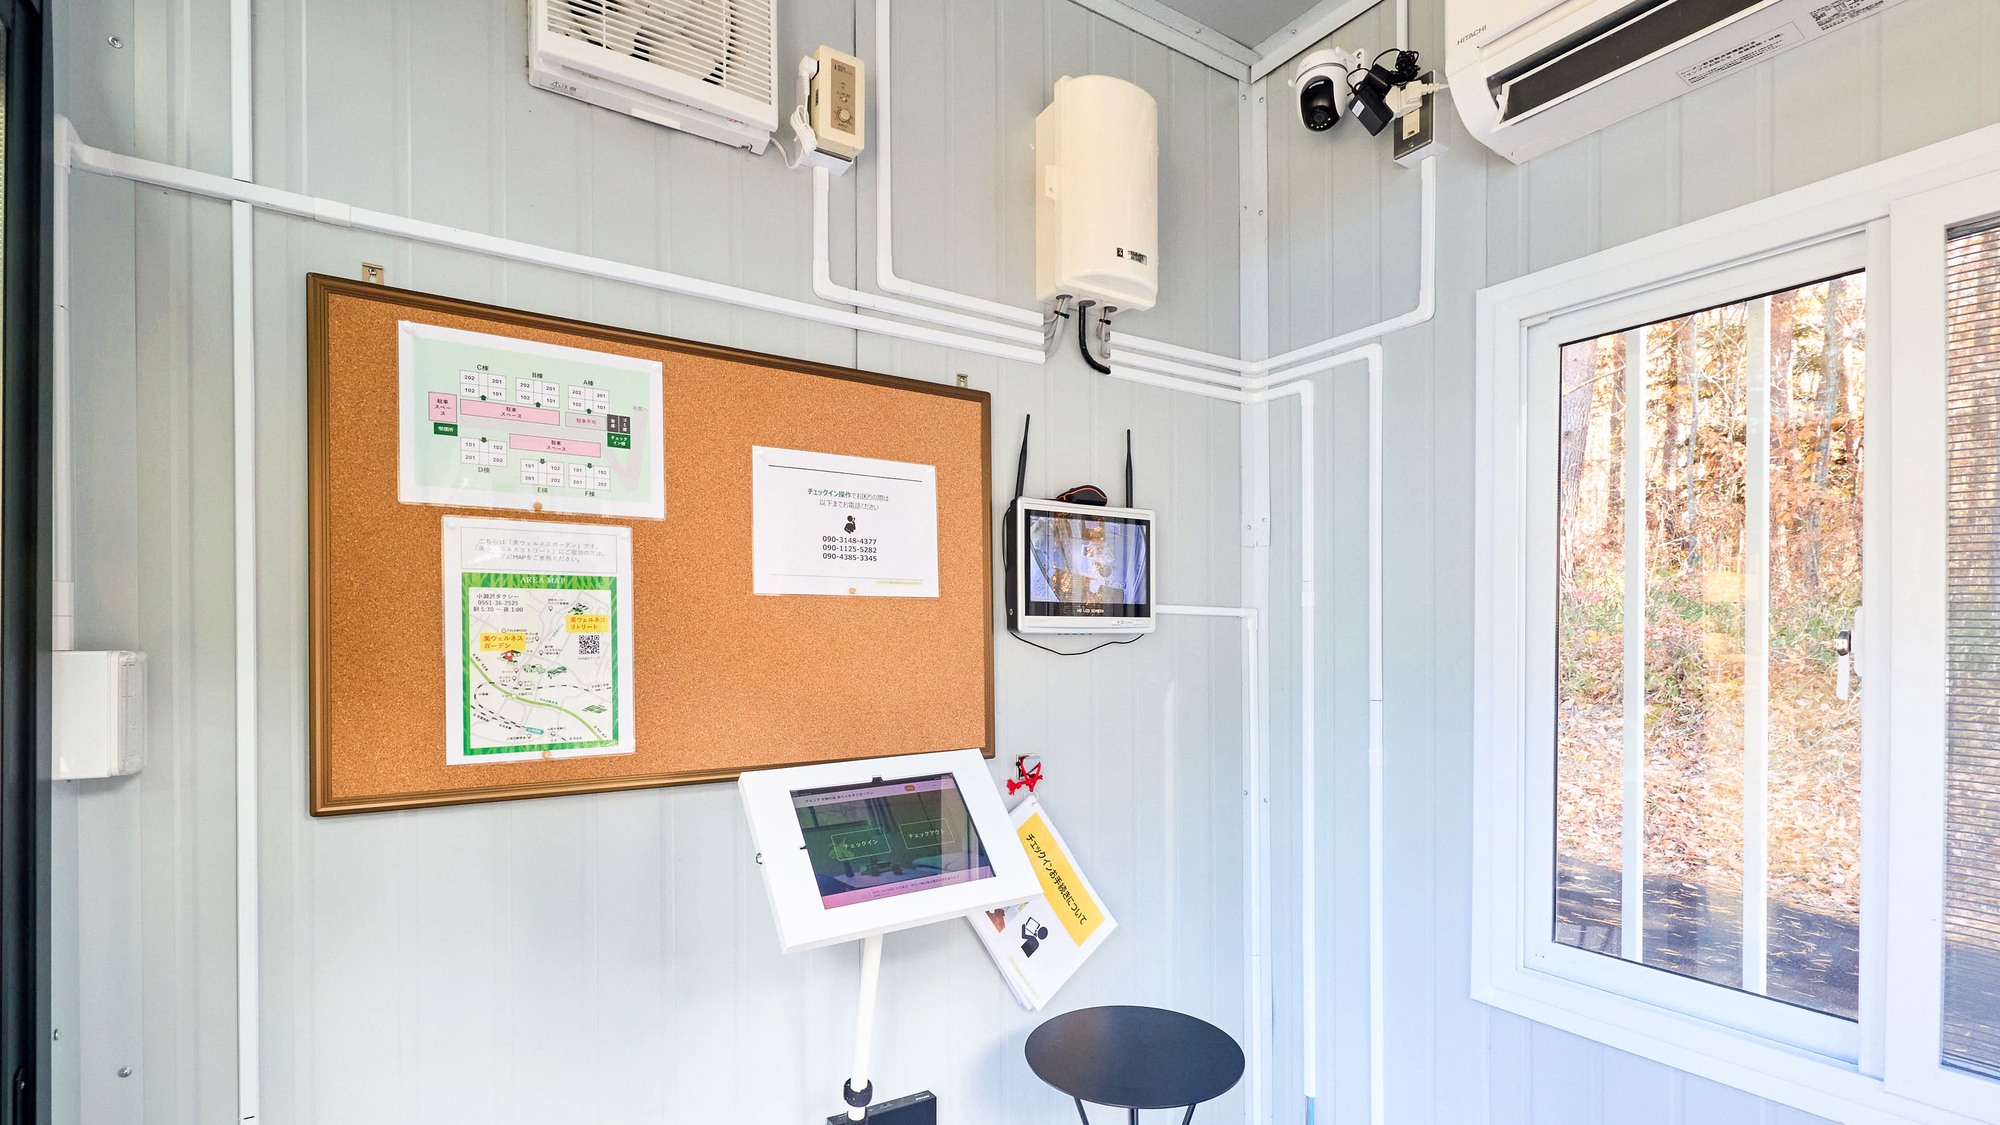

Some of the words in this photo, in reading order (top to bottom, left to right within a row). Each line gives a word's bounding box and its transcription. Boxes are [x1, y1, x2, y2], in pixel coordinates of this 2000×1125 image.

[1457, 25, 1487, 46] HITACHI
[807, 488, 889, 502] チェックイン操作でお困りの際は
[819, 499, 880, 511] 以下までお電話ください
[822, 536, 877, 545] 090-3148-4377
[822, 544, 877, 553] 090-1125-5282
[822, 553, 877, 562] 090-4385-3345
[520, 576, 544, 584] AREA
[908, 829, 945, 839] チェックアウト
[844, 839, 879, 850] チェックイン
[1026, 833, 1088, 925] チェックインお手続きについて
